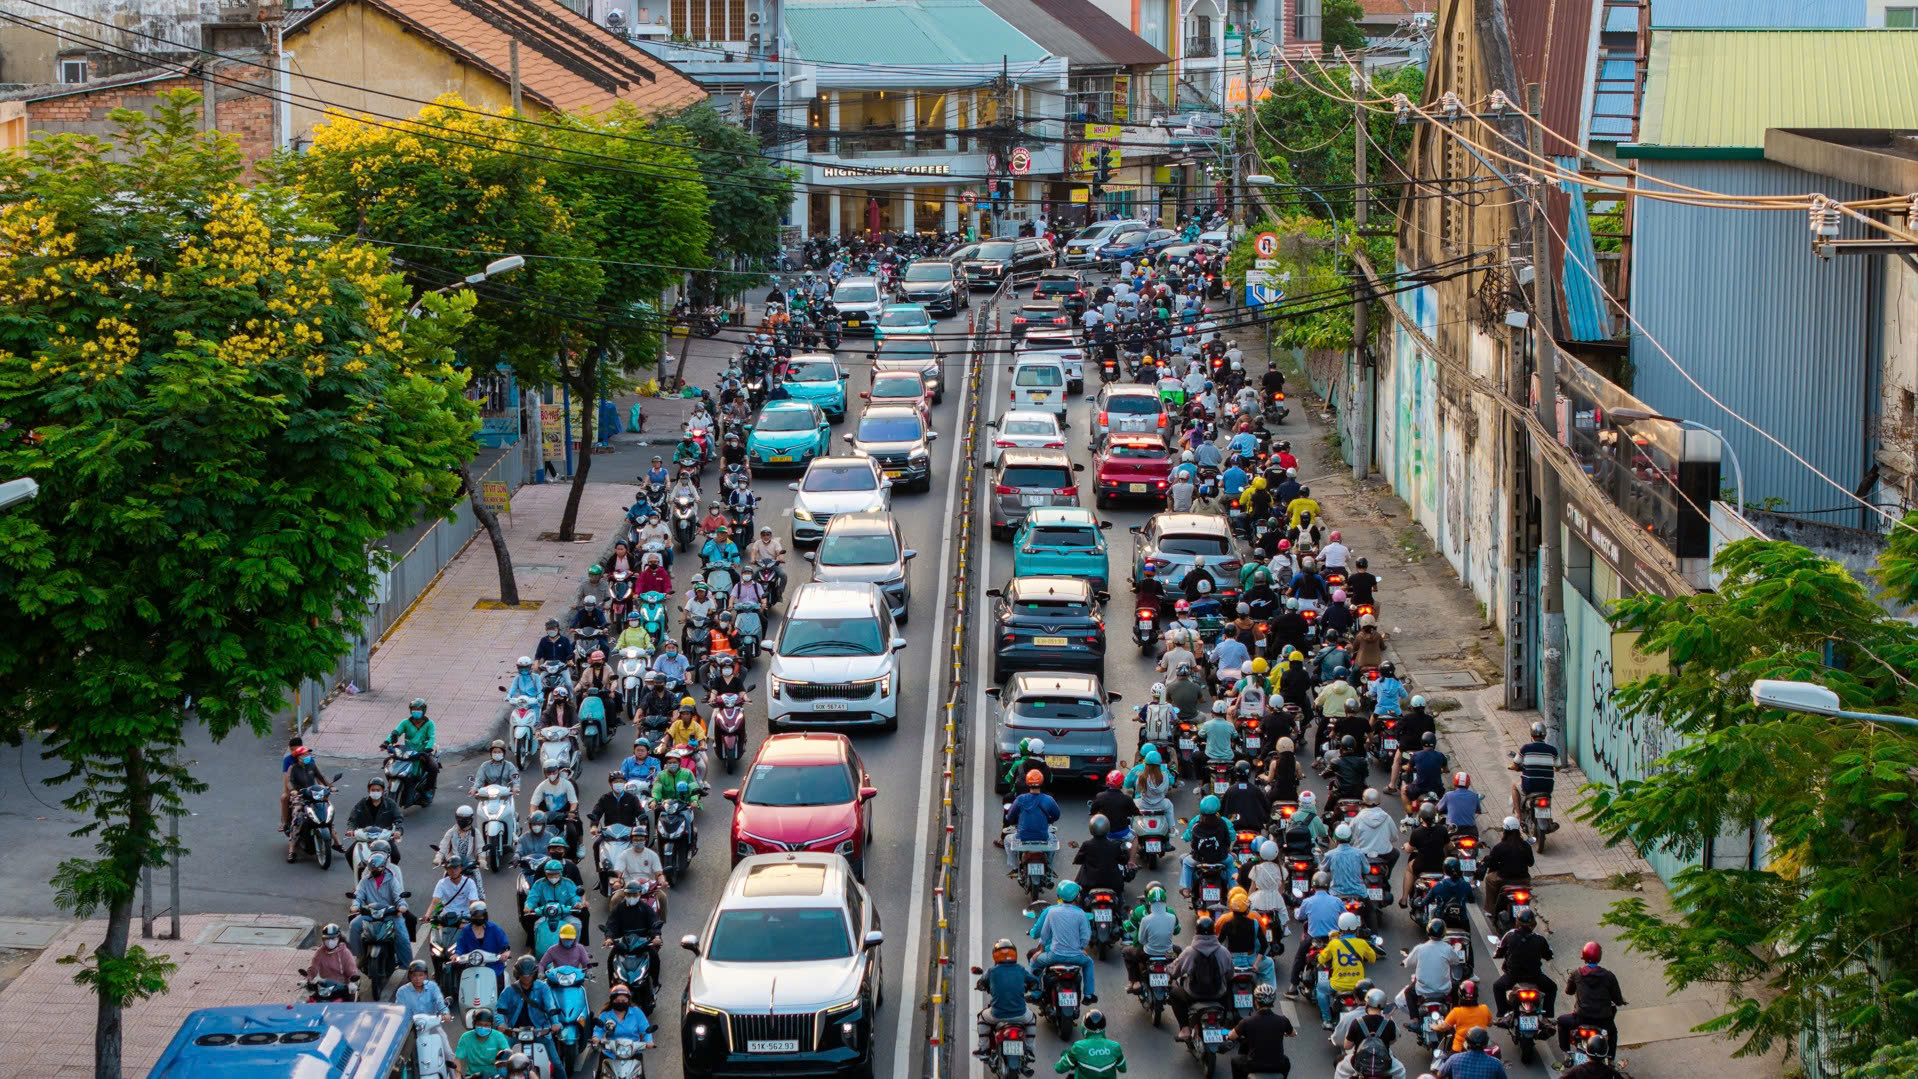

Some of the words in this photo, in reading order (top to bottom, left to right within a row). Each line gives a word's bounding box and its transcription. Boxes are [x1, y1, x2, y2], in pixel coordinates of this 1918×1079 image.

[902, 165, 950, 174] COFFEE
[1337, 948, 1361, 967] be
[1088, 1047, 1110, 1056] Grab
